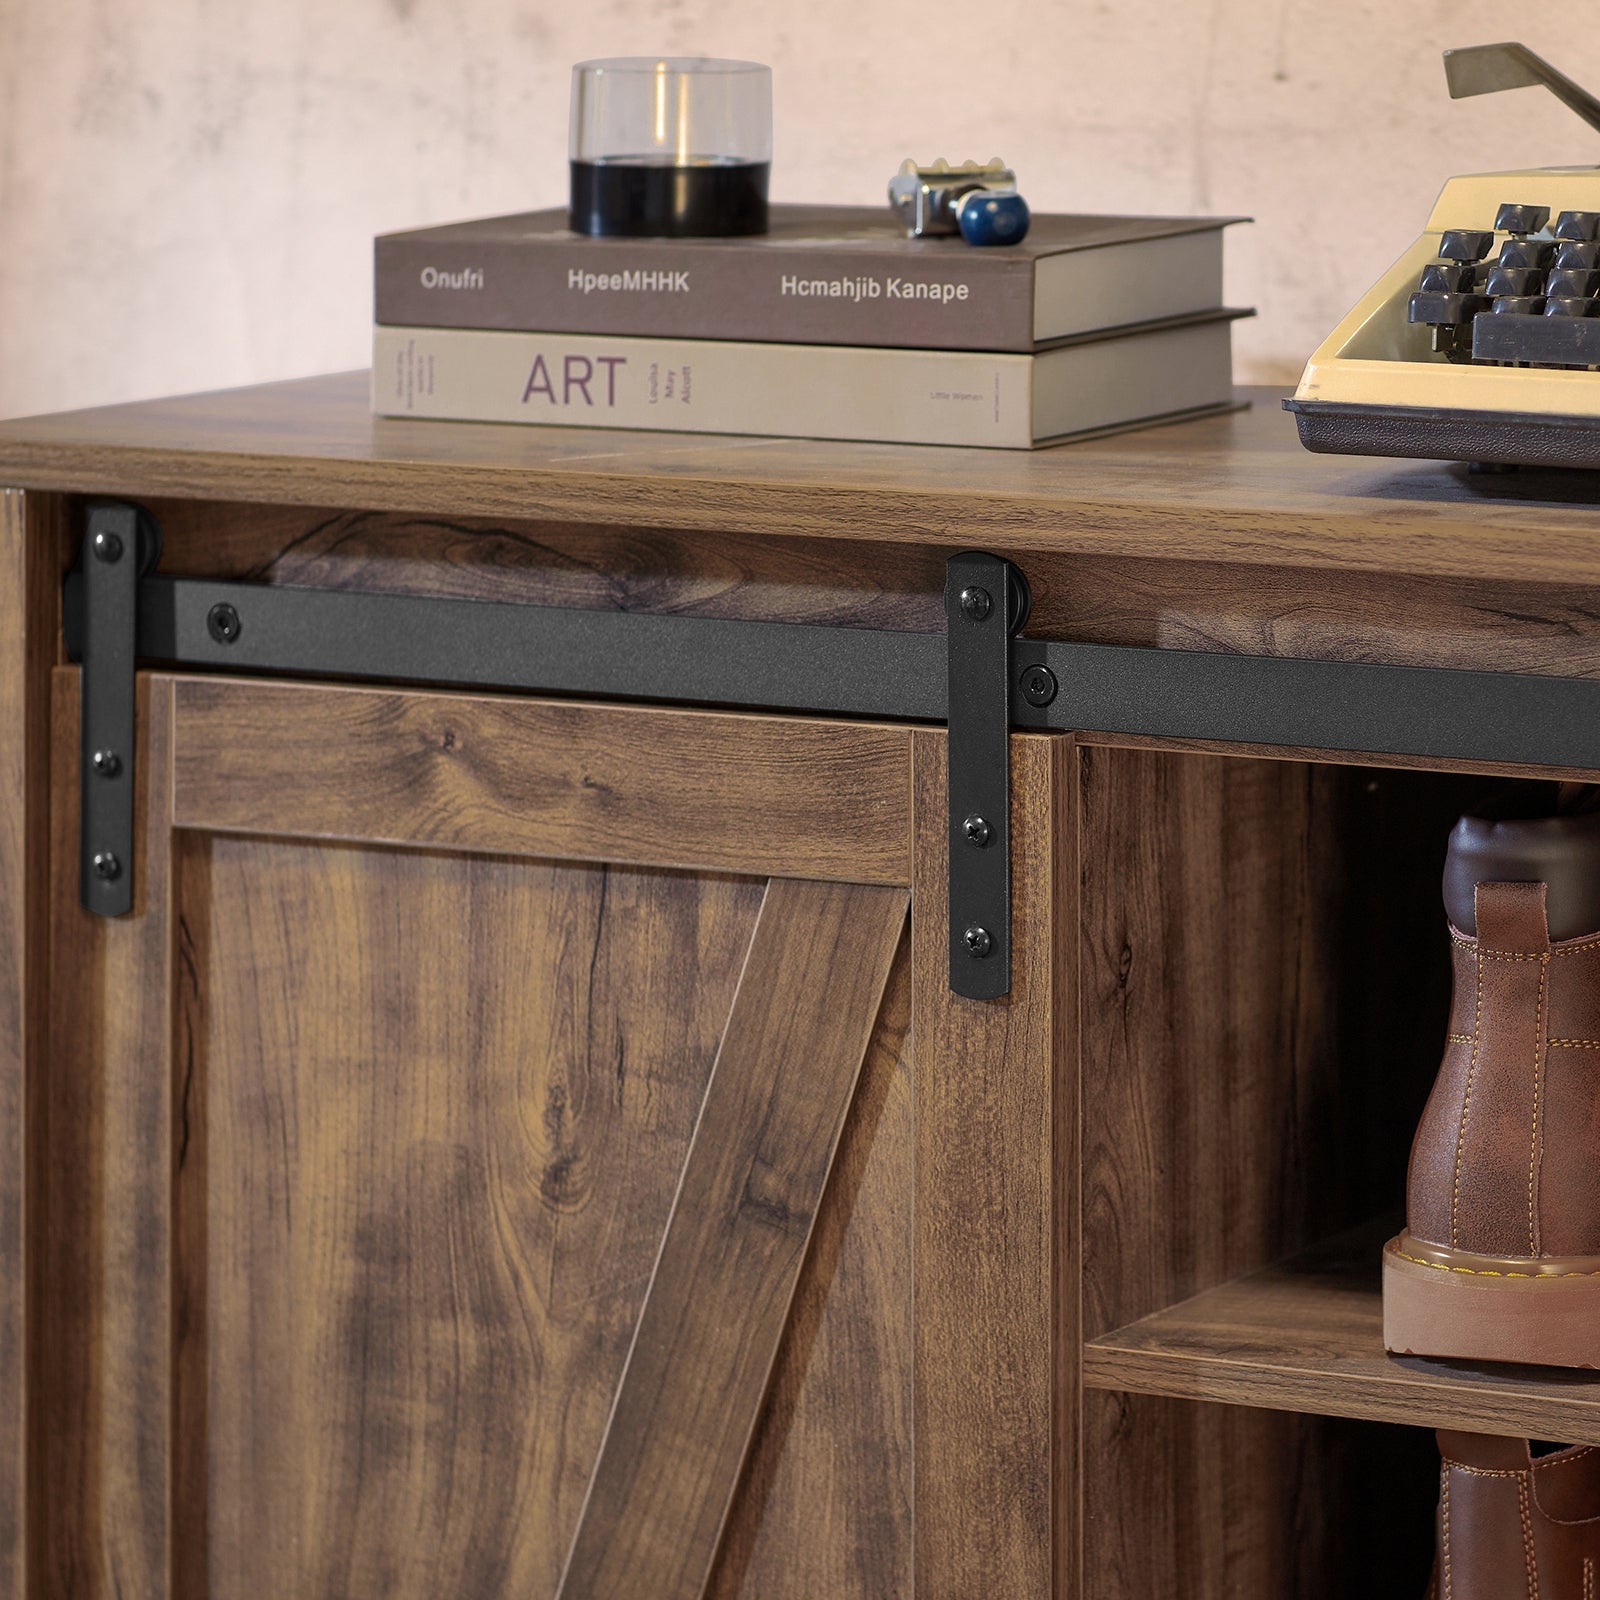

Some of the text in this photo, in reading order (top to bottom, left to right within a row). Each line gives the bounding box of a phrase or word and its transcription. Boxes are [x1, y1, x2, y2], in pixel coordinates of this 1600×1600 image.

[420, 266, 484, 290] Onufri
[567, 269, 690, 294] HpeeMHHK
[781, 275, 969, 305] Hcmahjib Kanape
[522, 353, 627, 407] ART
